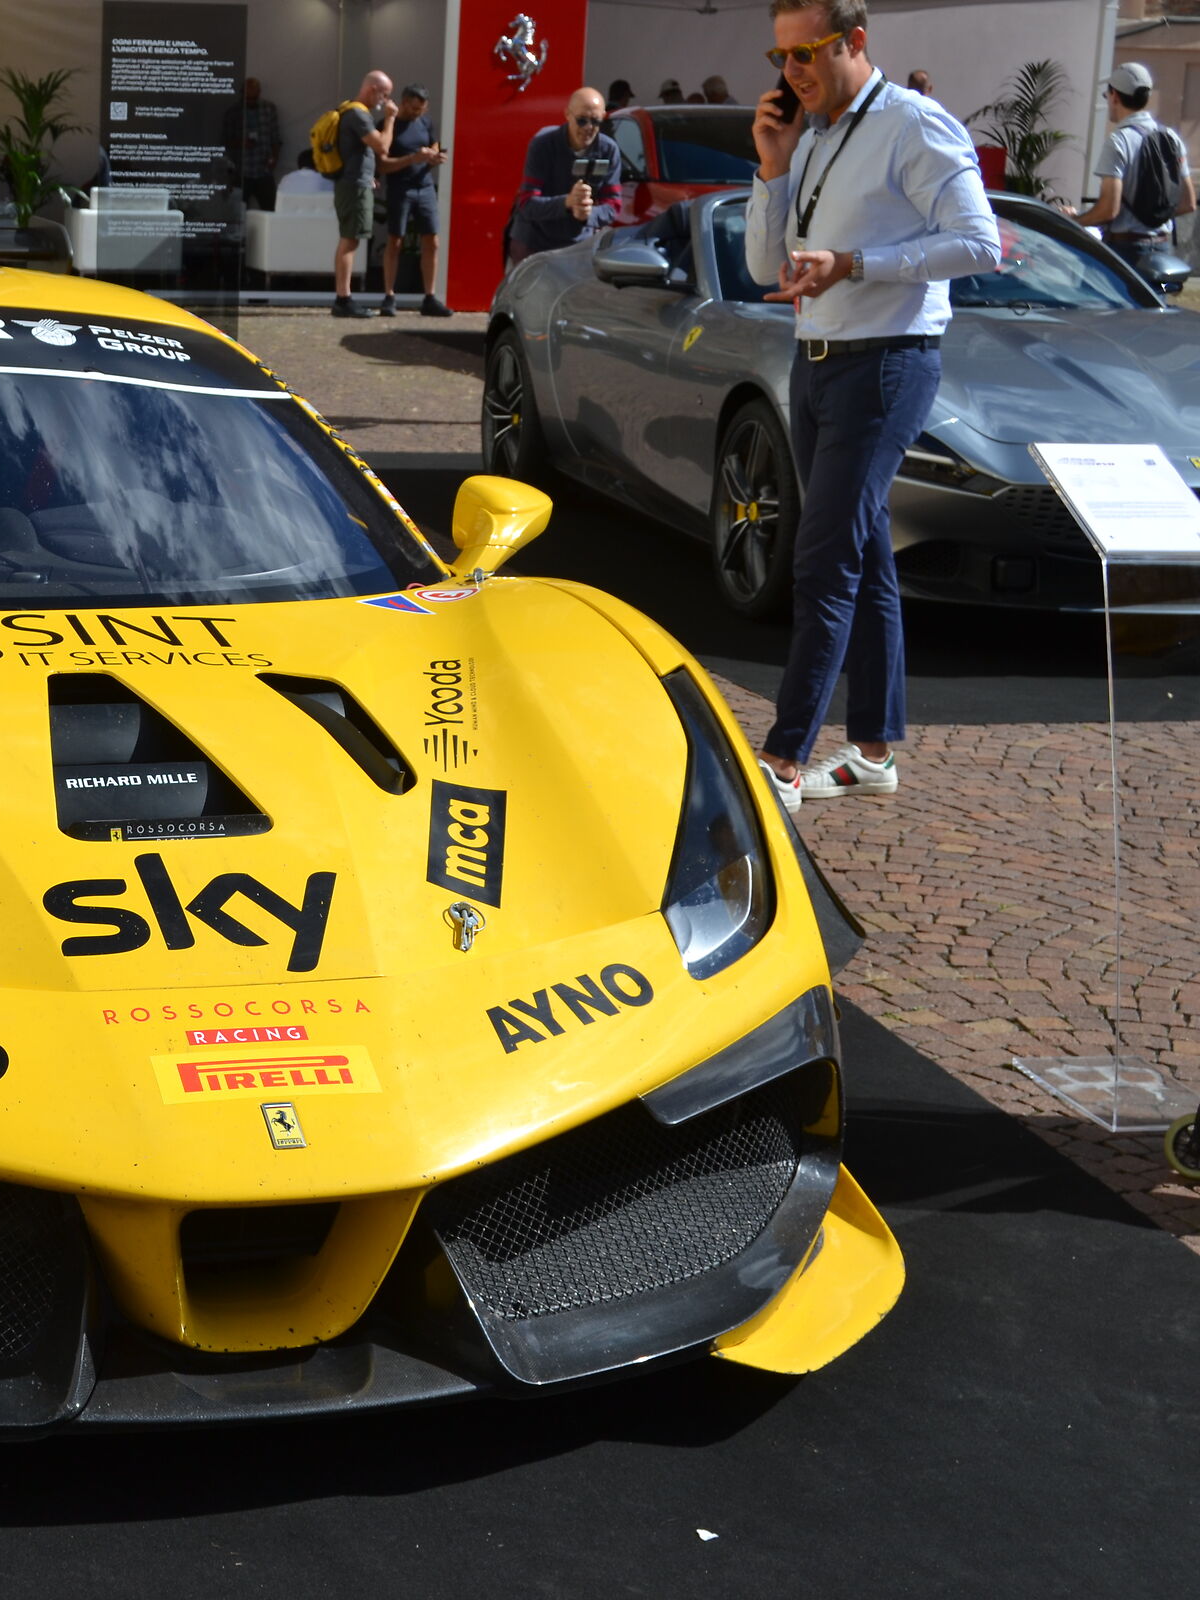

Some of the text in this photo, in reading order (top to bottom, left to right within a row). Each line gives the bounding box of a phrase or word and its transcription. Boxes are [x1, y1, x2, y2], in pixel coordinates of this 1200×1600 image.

[154, 46, 179, 54] SENZA
[89, 324, 185, 350] PELZER
[98, 337, 191, 363] GROUP
[1, 615, 236, 648] SINT
[19, 651, 273, 668] IT SERVICES
[65, 773, 198, 789] RICHARD MILLE
[127, 823, 225, 834] ROSSOCORSA
[443, 798, 491, 888] mca
[42, 853, 337, 973] sky
[103, 999, 371, 1025] ROSSOCORSA
[485, 962, 655, 1055] AYNO
[193, 1027, 301, 1044] RACING
[177, 1055, 354, 1093] PIRELLI
